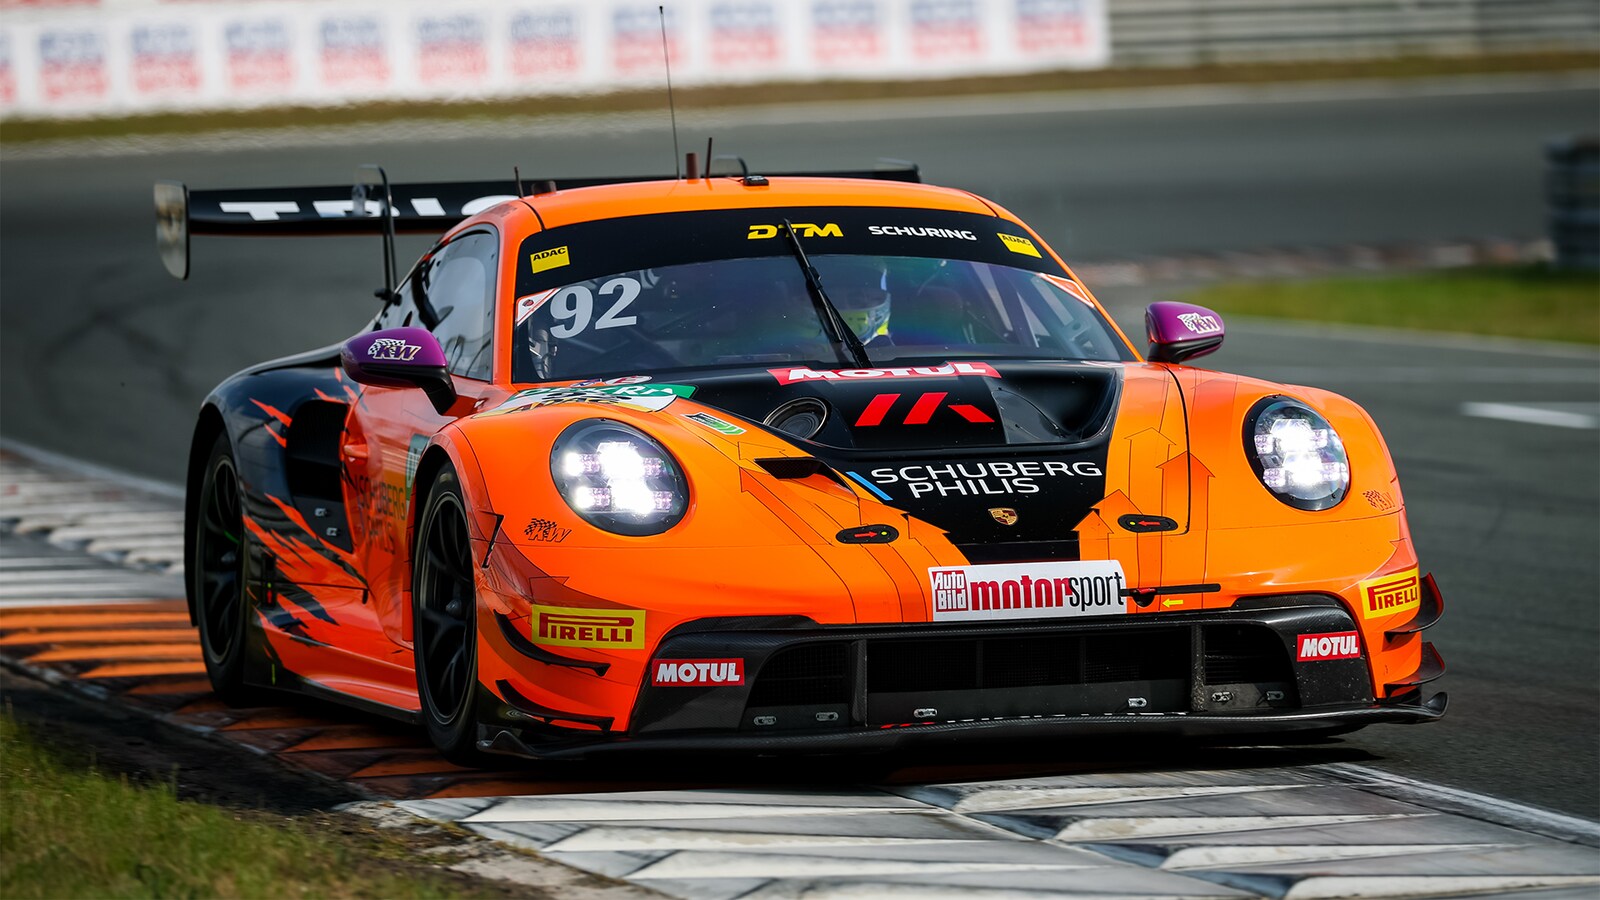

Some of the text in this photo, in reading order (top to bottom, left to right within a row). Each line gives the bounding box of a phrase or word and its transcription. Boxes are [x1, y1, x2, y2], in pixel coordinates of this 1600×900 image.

[747, 222, 844, 241] DTM
[867, 225, 978, 242] SCHURING
[1001, 234, 1032, 247] ADAC
[532, 247, 567, 263] ADAC
[549, 277, 642, 339] 92
[371, 341, 422, 361] KW
[788, 362, 987, 381] MOTUL
[870, 461, 1103, 485] SCHUBERG
[907, 477, 1041, 499] PHILIS
[526, 520, 572, 543] KW
[933, 570, 965, 590] Auto
[937, 588, 968, 610] Bild
[1366, 576, 1419, 612] PIRELLI
[538, 611, 635, 643] PIRELLI
[1300, 635, 1359, 658] MOTUL
[655, 662, 741, 683] MOTUL
